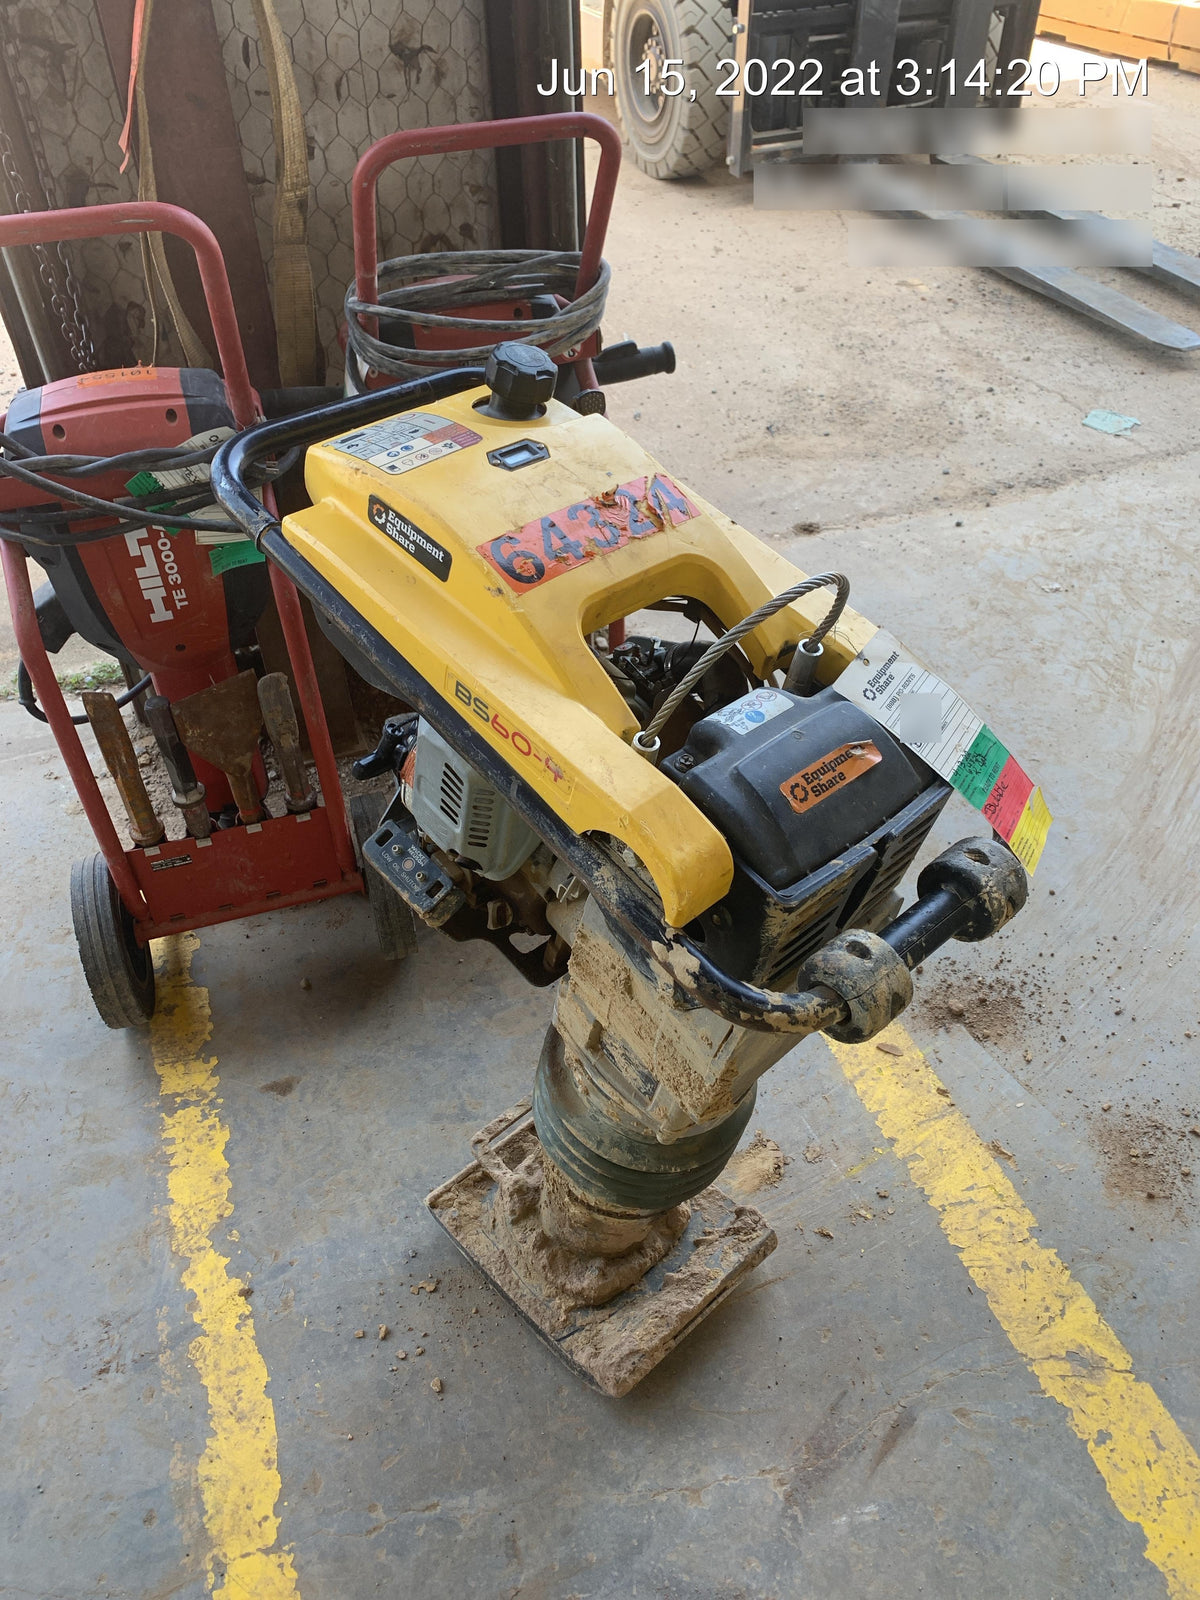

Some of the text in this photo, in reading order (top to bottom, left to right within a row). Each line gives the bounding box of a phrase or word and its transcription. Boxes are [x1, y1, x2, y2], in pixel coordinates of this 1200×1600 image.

[385, 522, 416, 553] Share
[387, 509, 445, 563] Equipment
[172, 587, 189, 610] TE
[867, 650, 900, 689] Equipment
[875, 673, 895, 695] Share
[810, 771, 847, 798] Share
[381, 850, 394, 863] LOW
[392, 862, 400, 872] OIL
